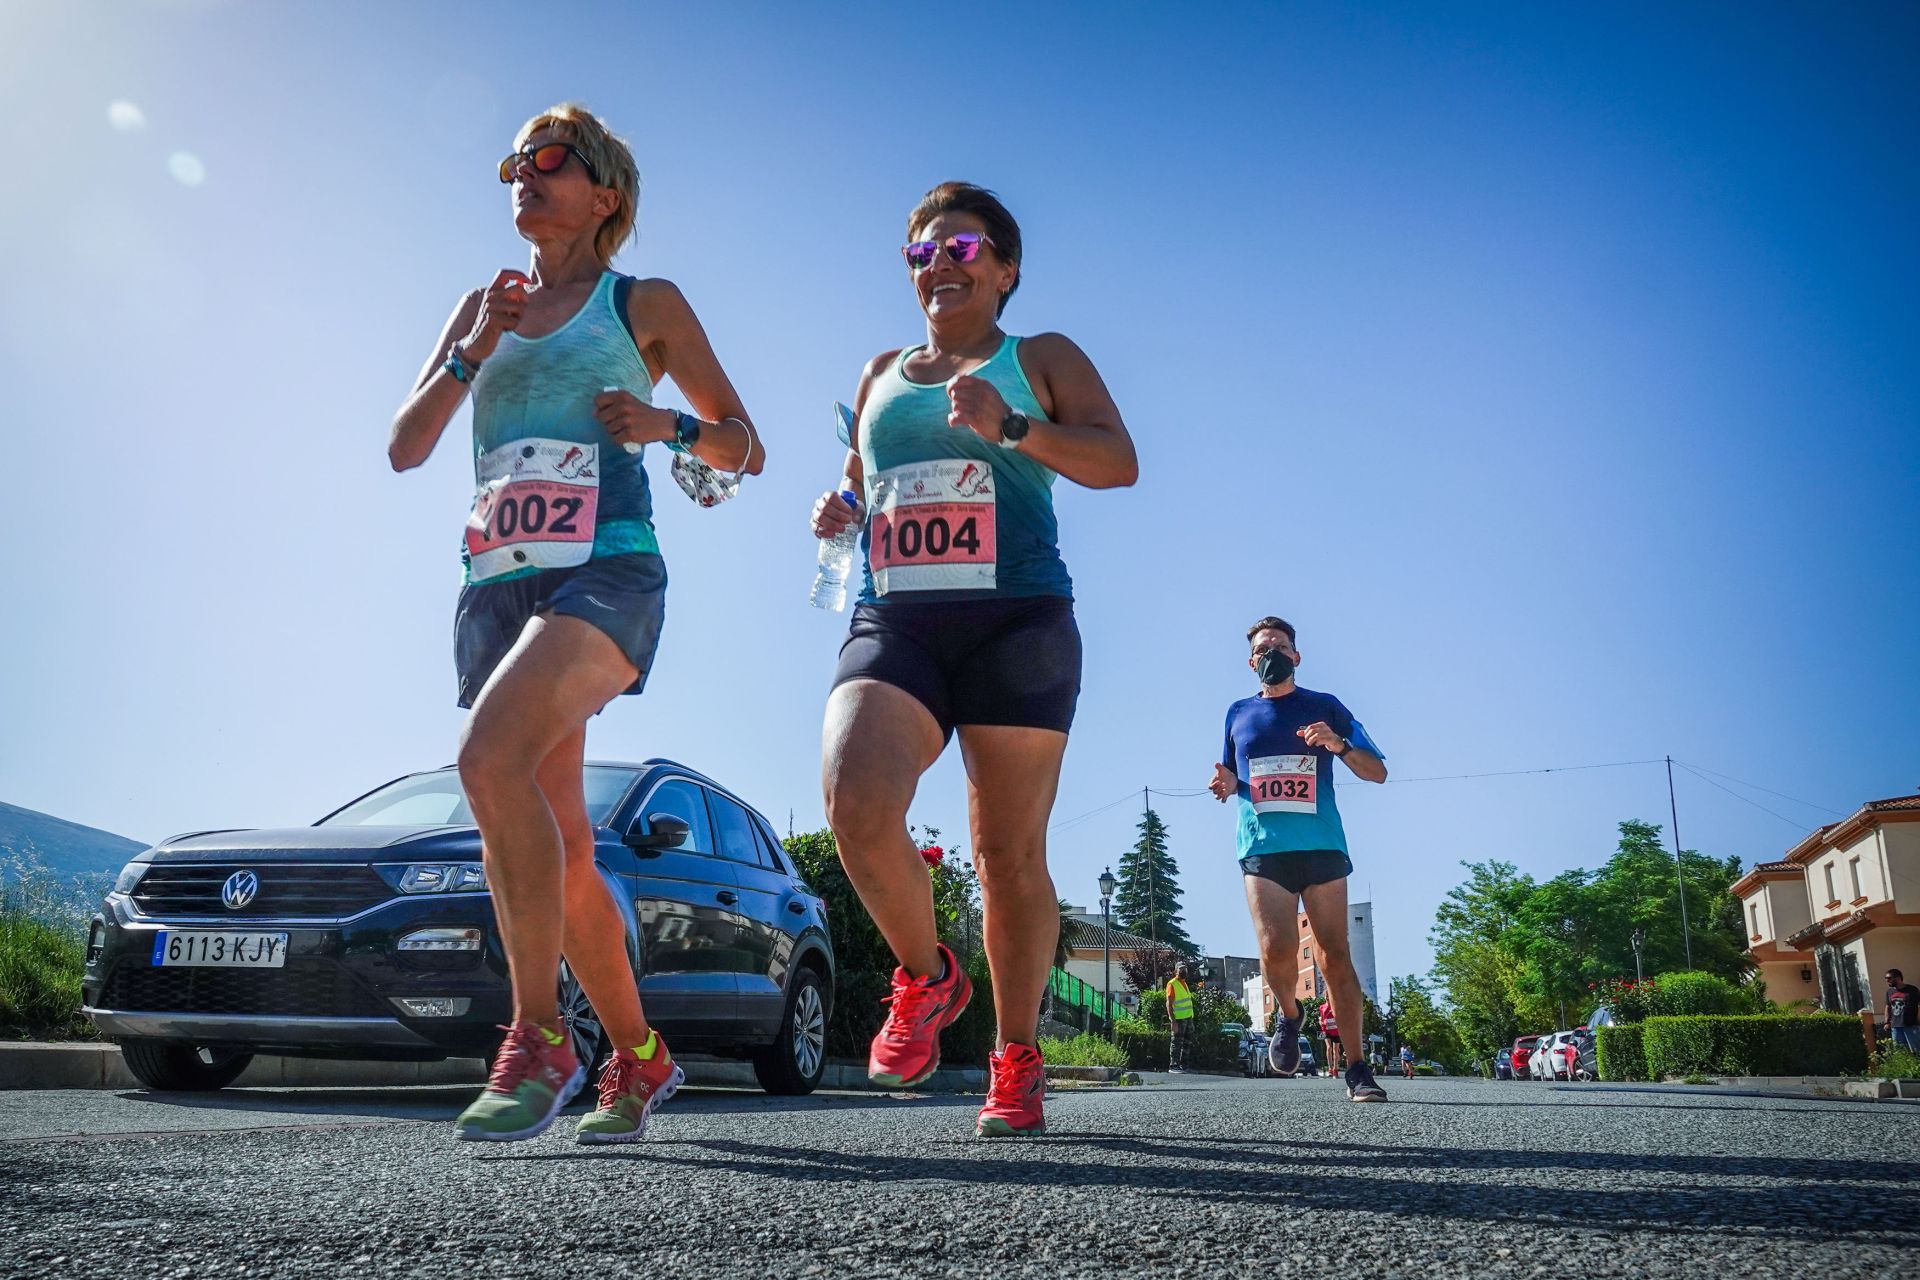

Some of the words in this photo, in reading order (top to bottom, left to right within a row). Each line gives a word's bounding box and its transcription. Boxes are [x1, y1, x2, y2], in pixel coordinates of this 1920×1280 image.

[881, 517, 980, 561] 1004
[1258, 780, 1309, 799] 1032
[169, 936, 226, 961] 6113
[232, 936, 279, 962] KJY
